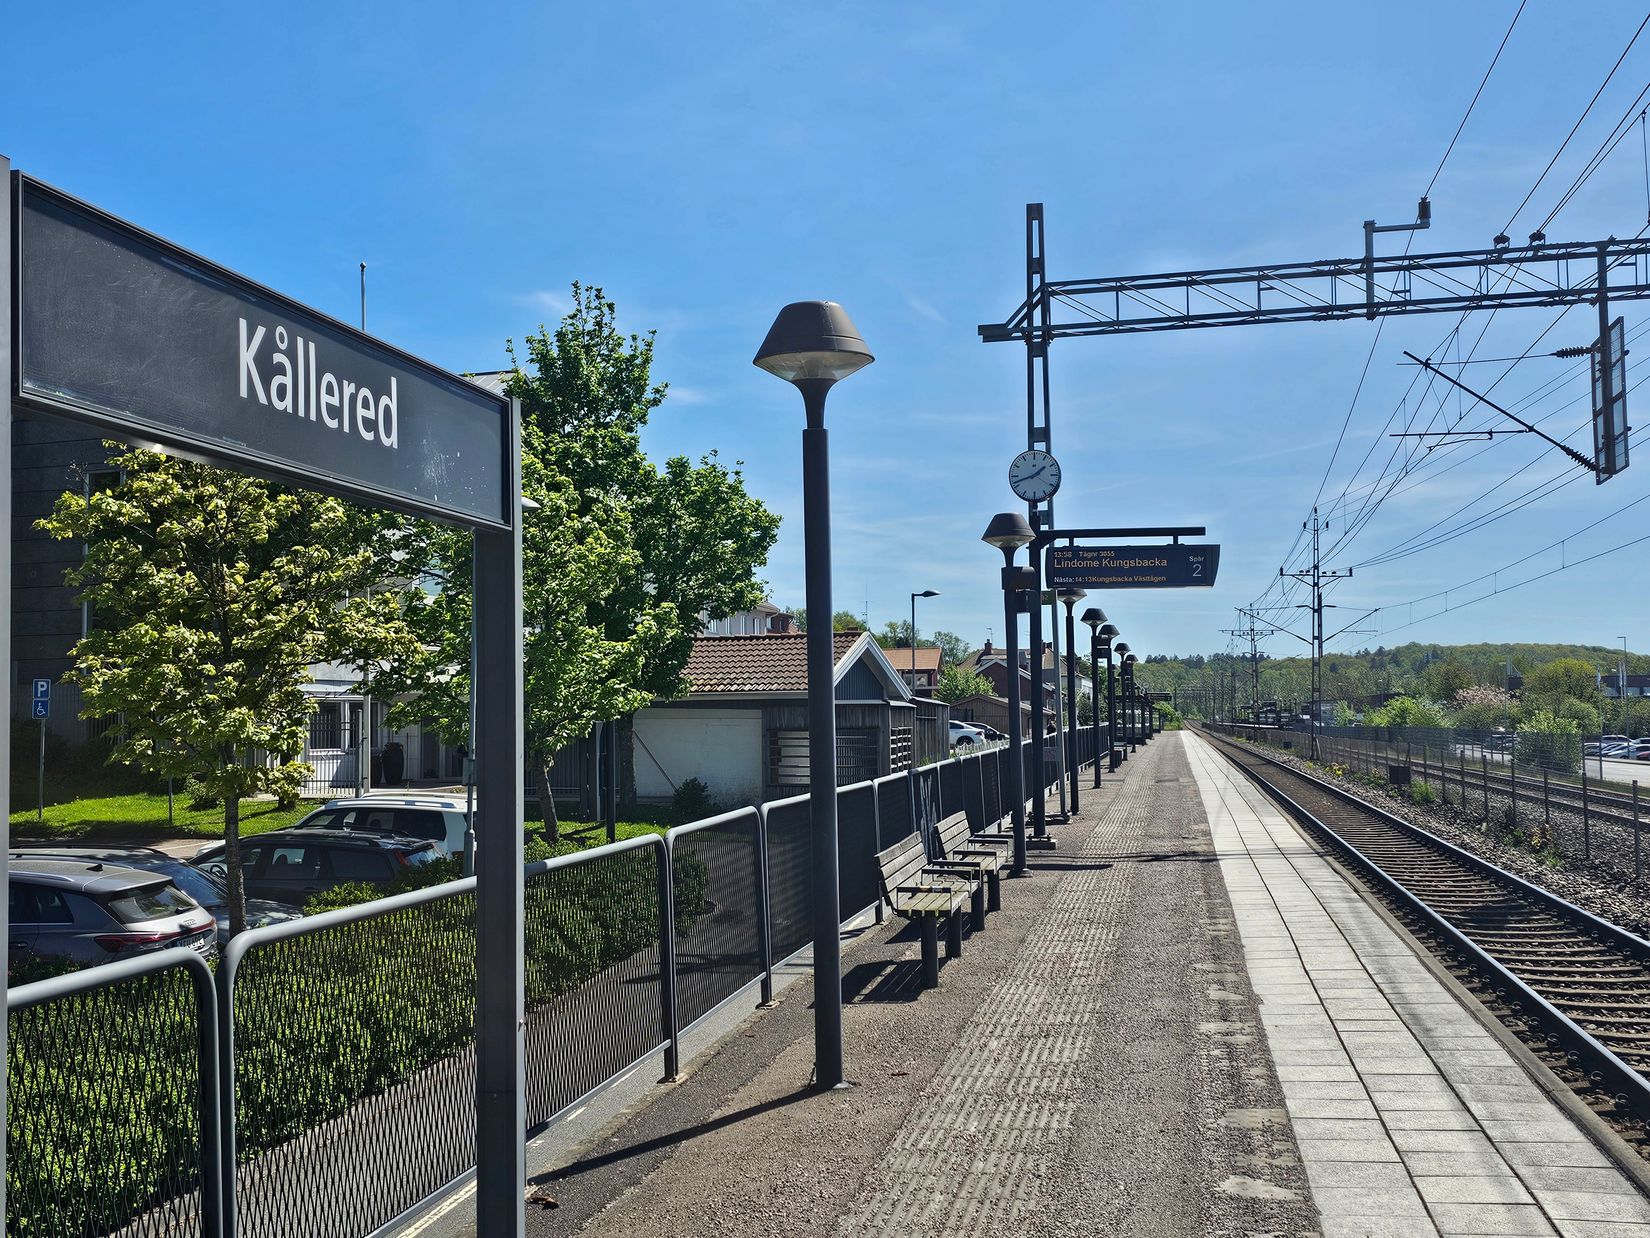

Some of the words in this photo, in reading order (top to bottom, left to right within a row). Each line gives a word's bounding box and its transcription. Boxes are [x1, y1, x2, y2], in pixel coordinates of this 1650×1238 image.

[239, 317, 398, 449] Kållered
[1054, 559, 1100, 568] Lindome
[1102, 558, 1167, 568] Kungsbacka
[1192, 564, 1202, 577] 2
[37, 681, 48, 697] P
